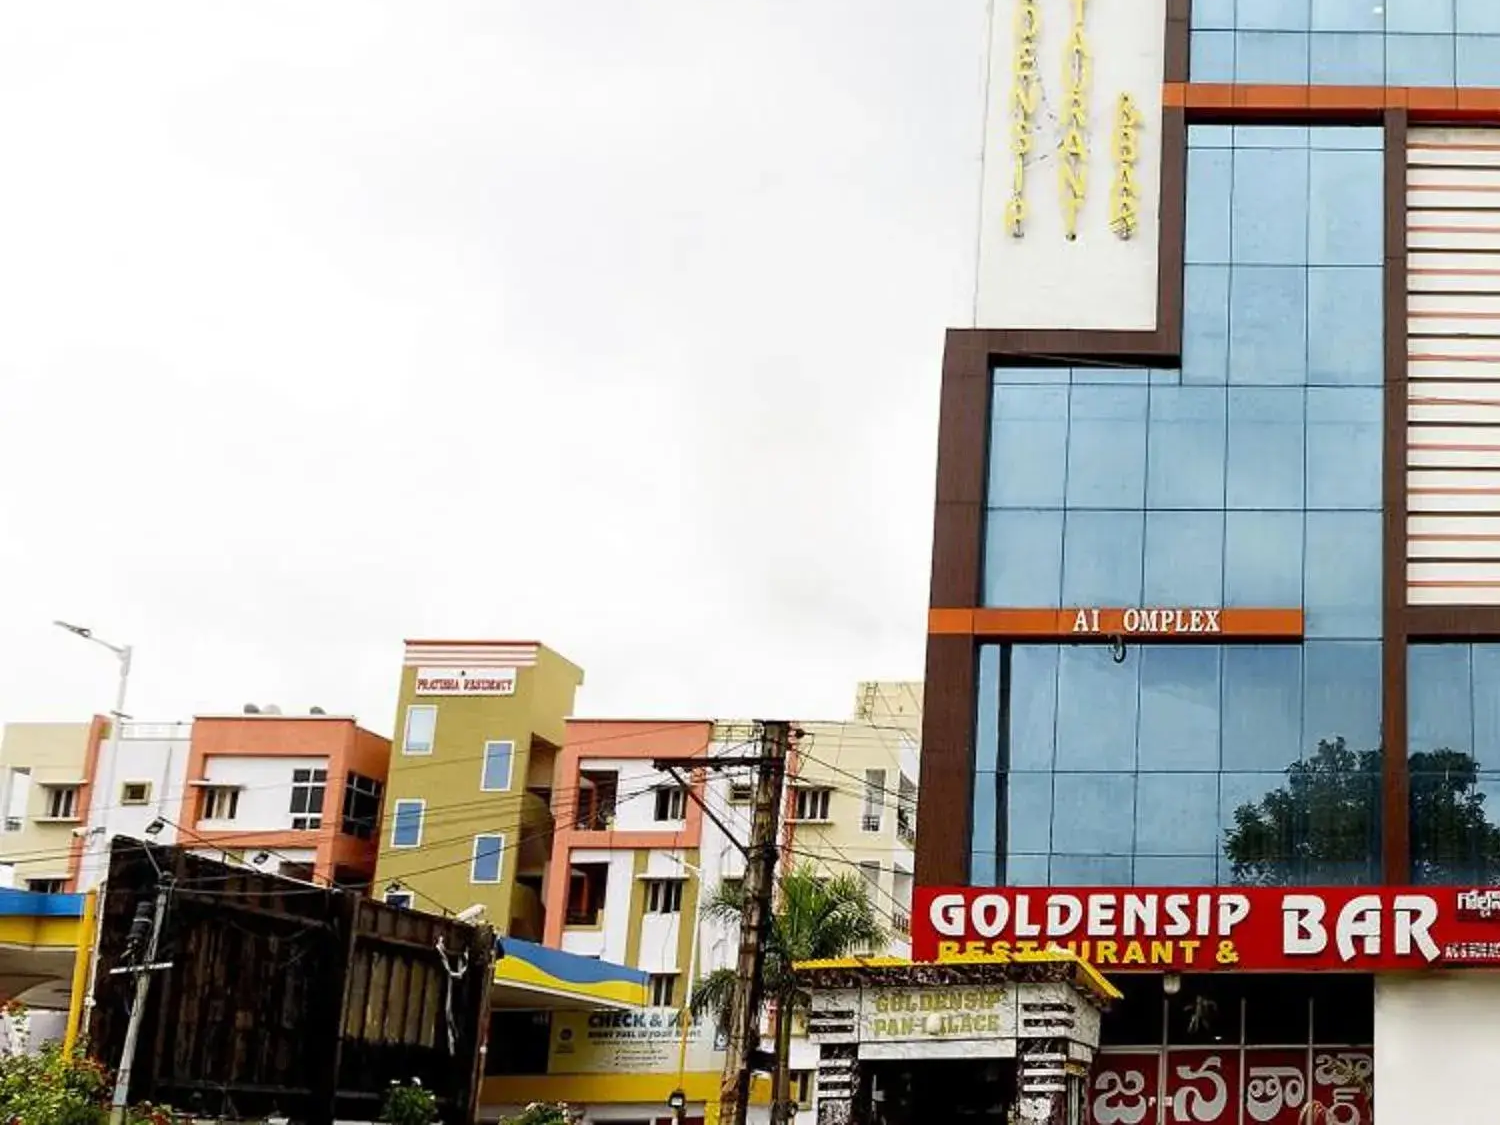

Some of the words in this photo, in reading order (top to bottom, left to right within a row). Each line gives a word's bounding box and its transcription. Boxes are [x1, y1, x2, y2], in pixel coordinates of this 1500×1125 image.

[929, 894, 1250, 938] GOLDENSIP
[1281, 894, 1441, 963] BAR
[938, 940, 1201, 965] RESTURANT
[1215, 940, 1240, 965] &
[874, 990, 1005, 1013] GOLDENSIP
